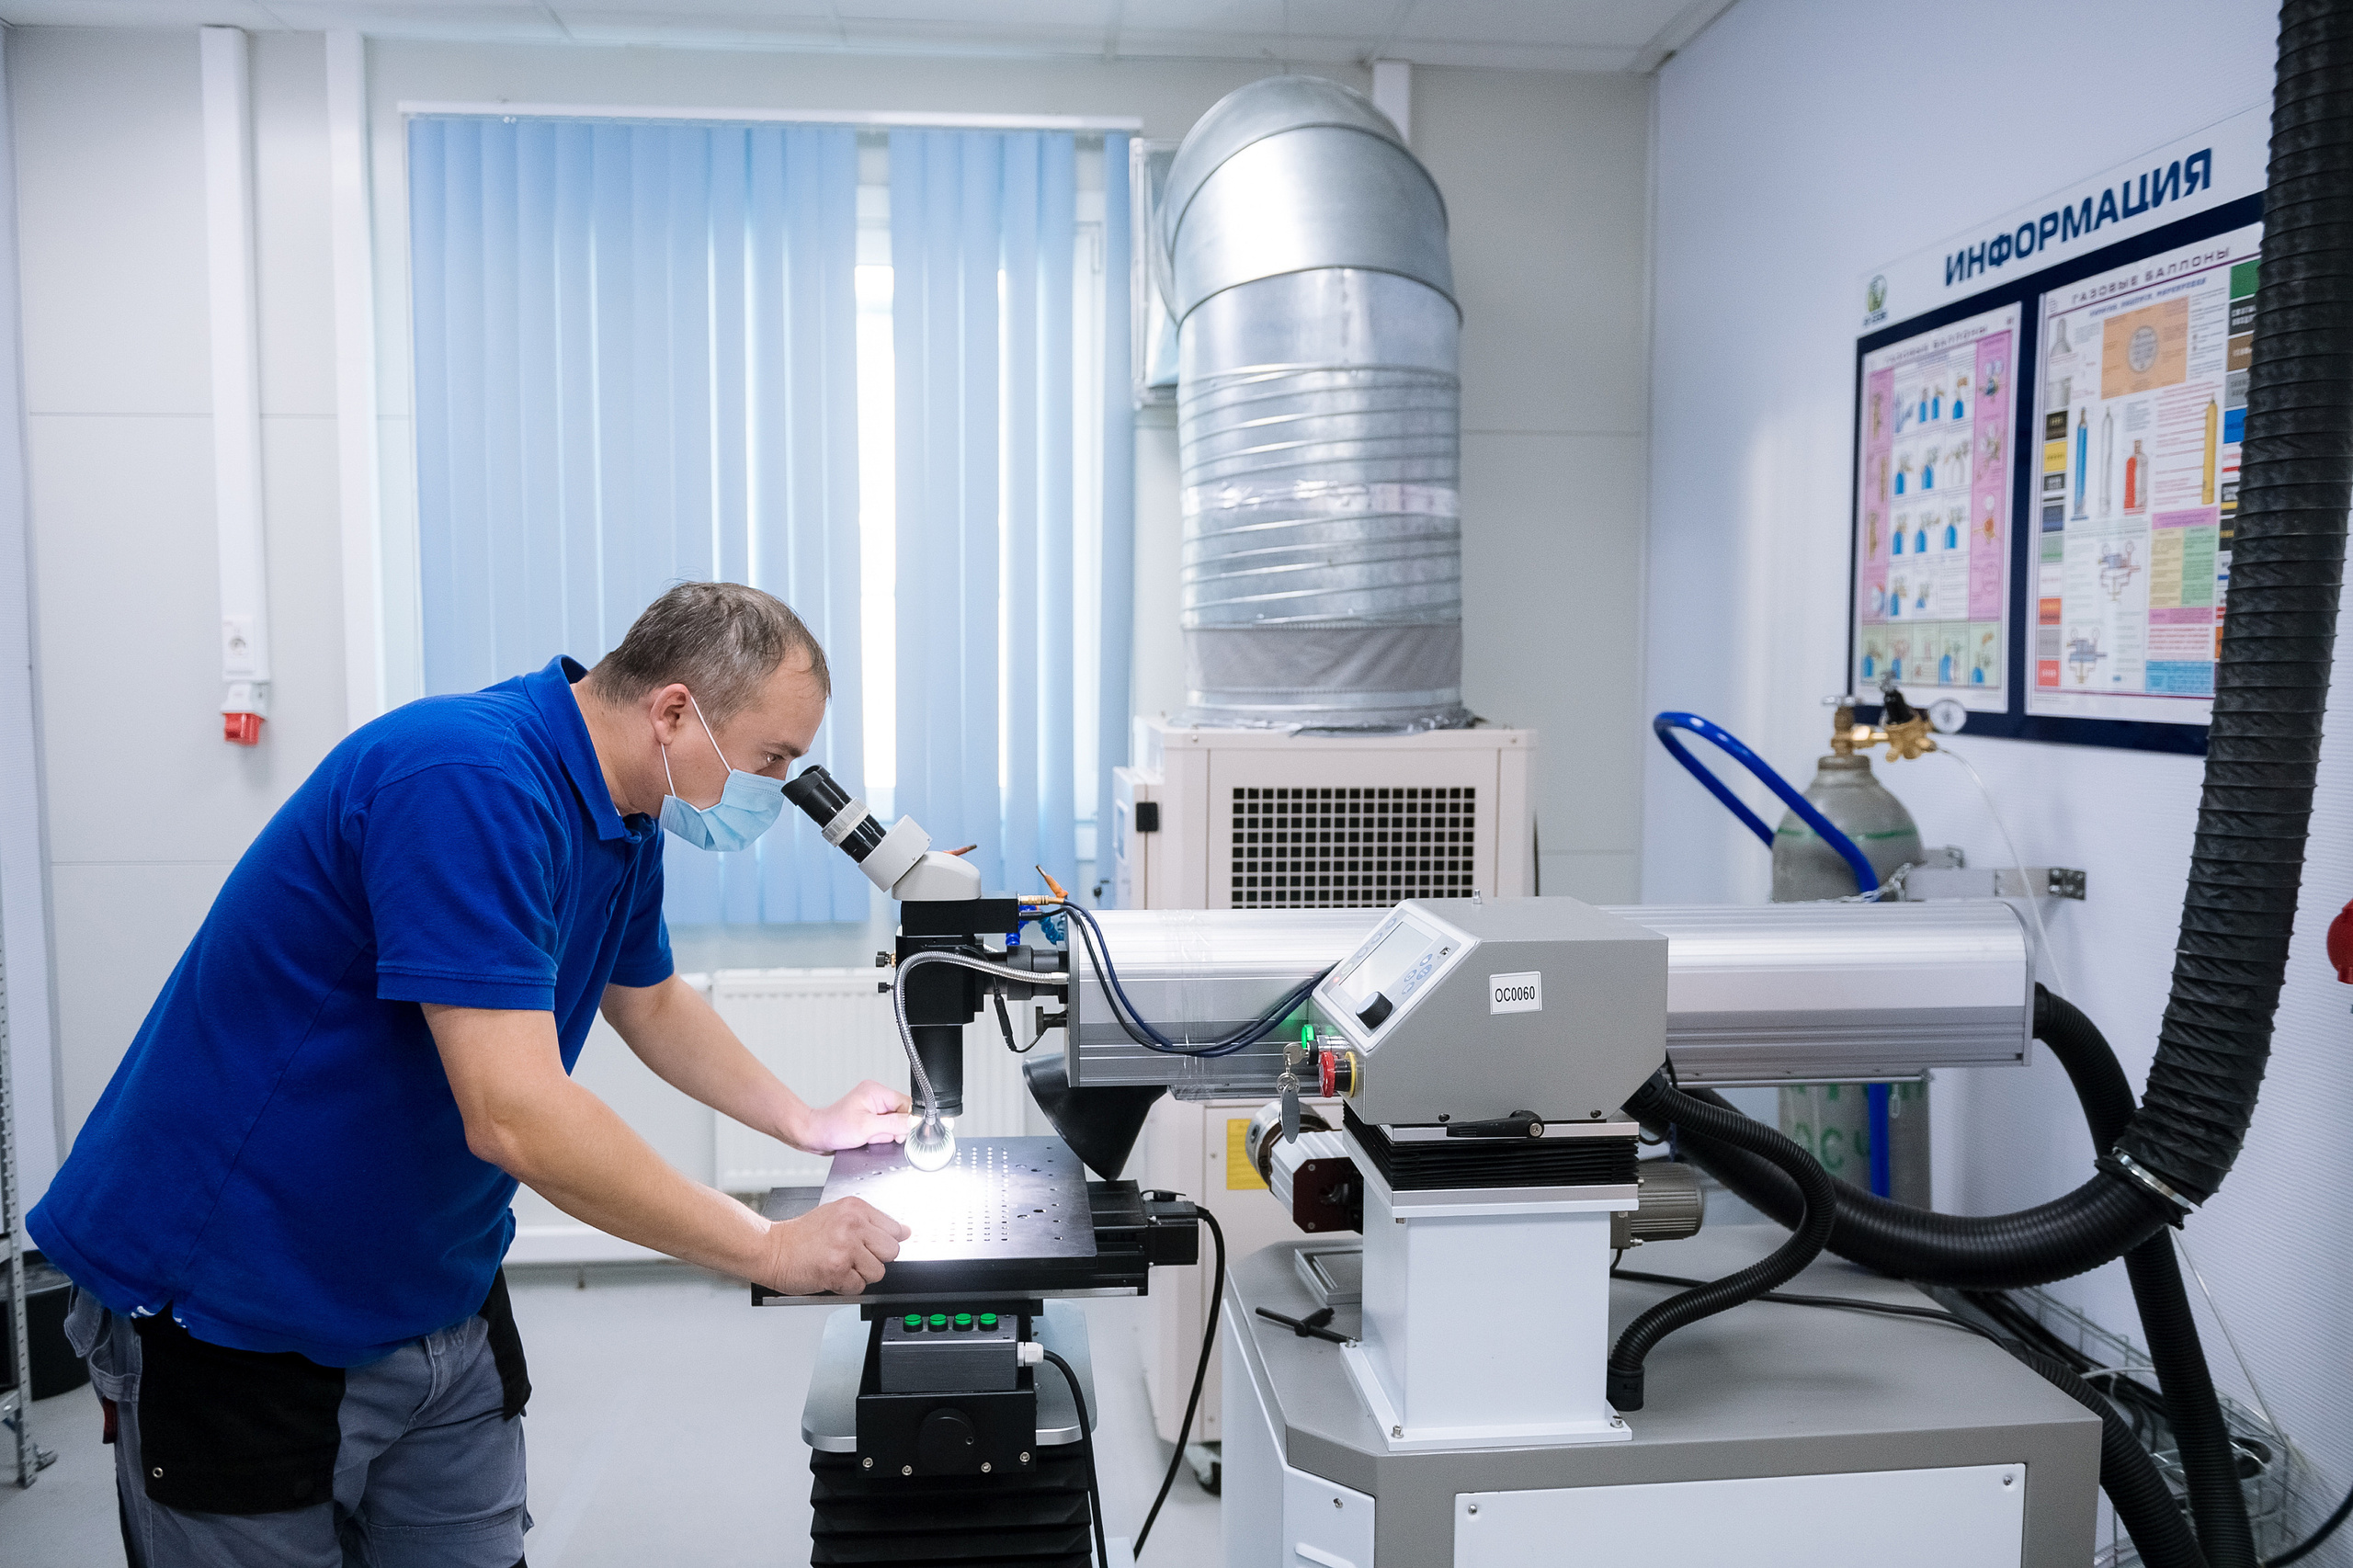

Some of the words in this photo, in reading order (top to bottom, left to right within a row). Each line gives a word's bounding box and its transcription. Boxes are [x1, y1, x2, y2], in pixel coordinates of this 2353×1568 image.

[1944, 148, 2212, 287] ИНФОРМАЦИЯ
[2071, 274, 2139, 305] ГАЗОВЫЕ
[2144, 247, 2231, 283] БАЛЛОНЫ
[1495, 985, 1535, 1003] OC0060
